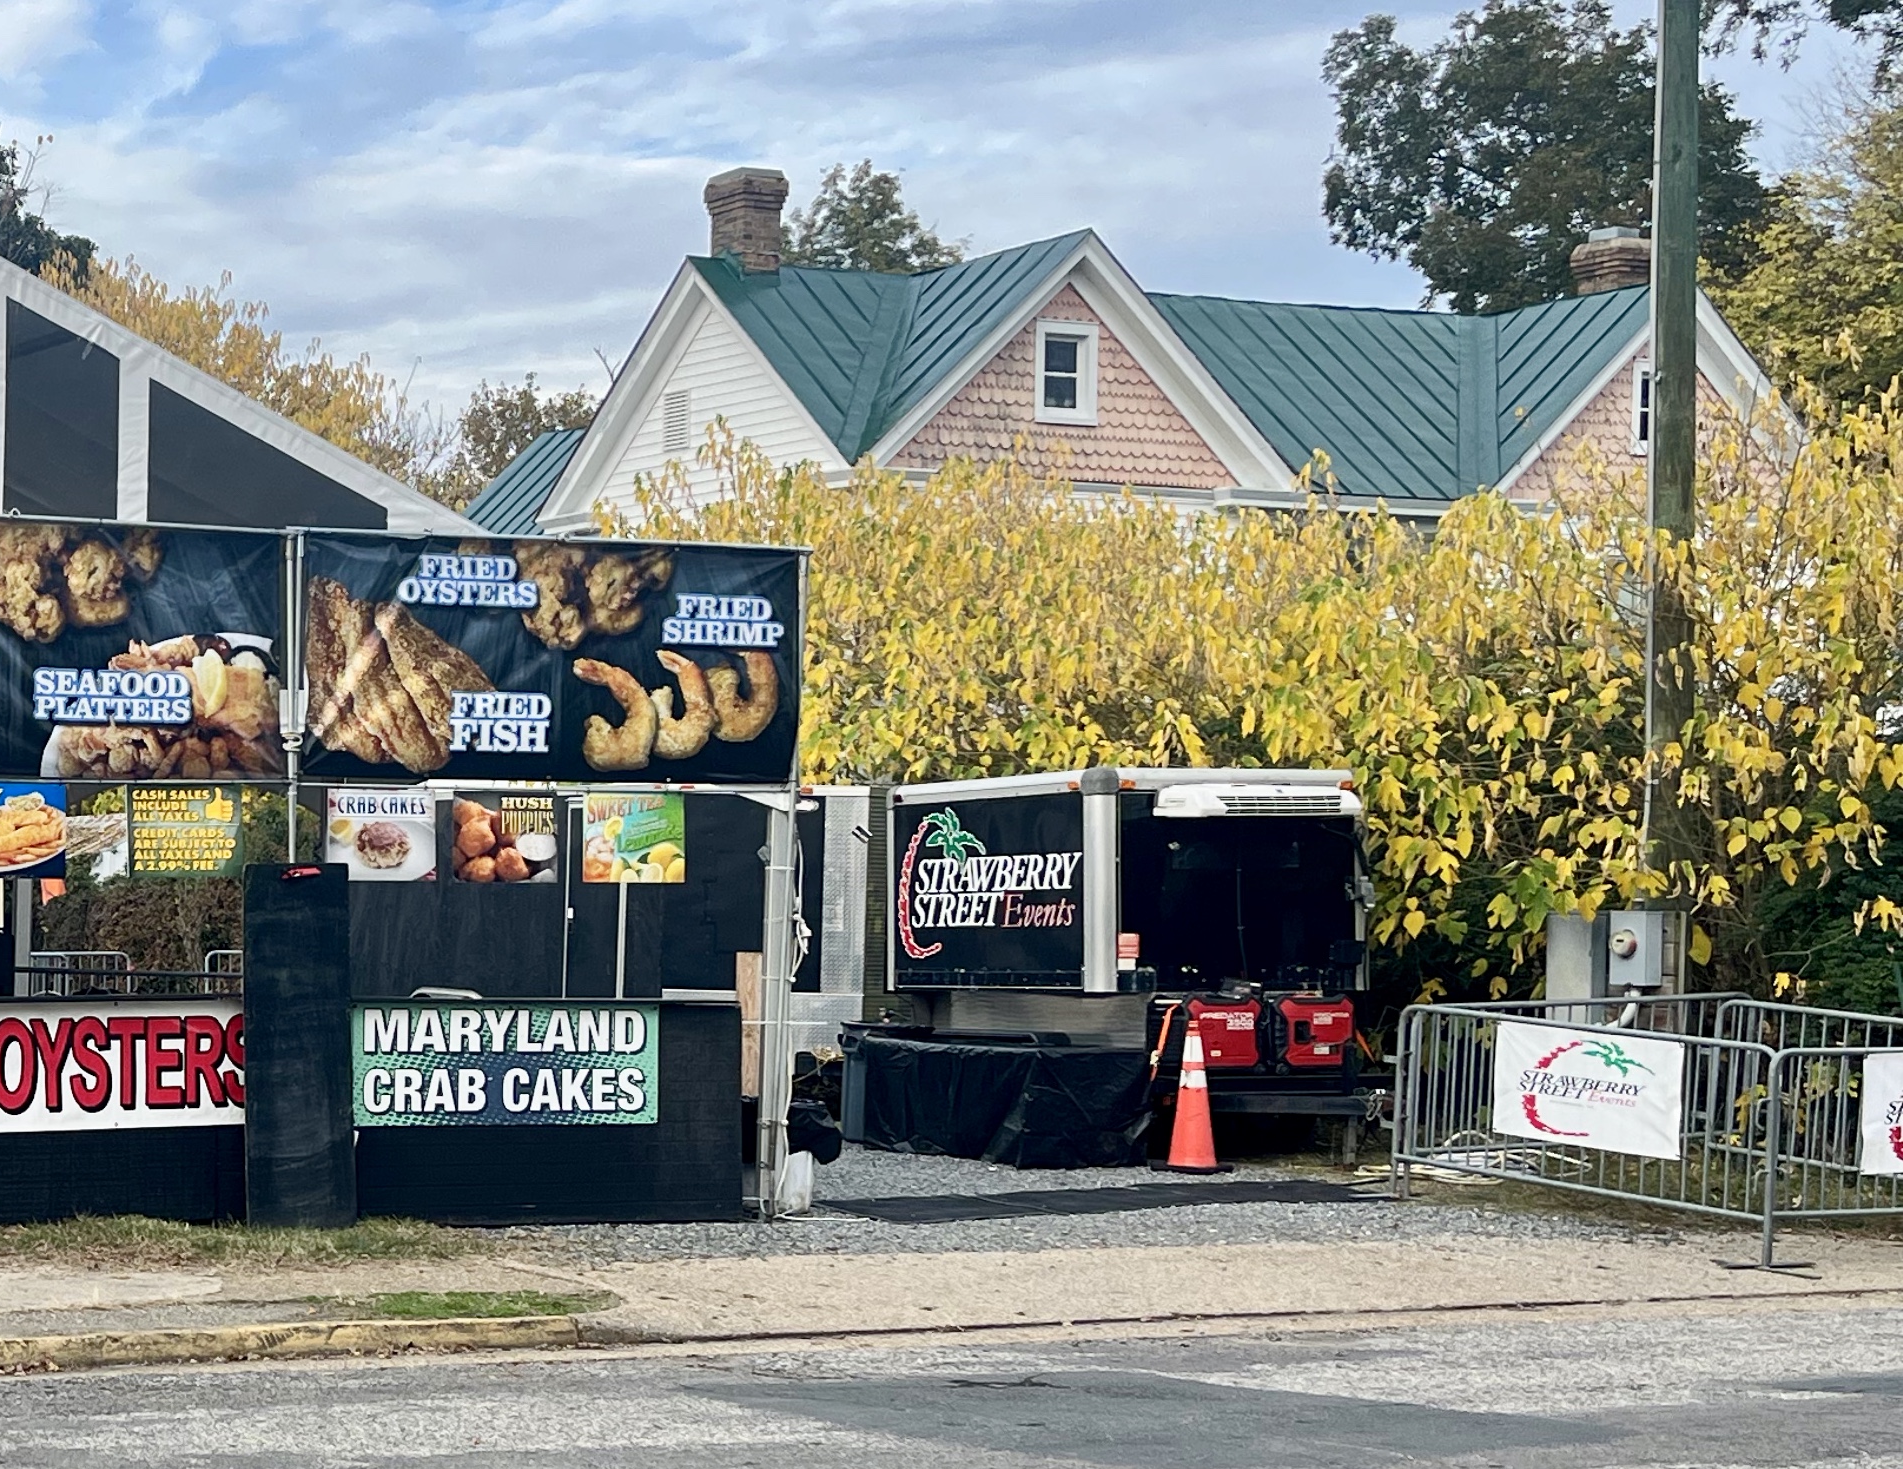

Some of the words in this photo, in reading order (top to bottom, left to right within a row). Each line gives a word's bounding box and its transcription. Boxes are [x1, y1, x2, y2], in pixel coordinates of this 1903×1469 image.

[419, 555, 517, 580] FRIED
[398, 580, 537, 607] OYSTERS
[675, 595, 773, 622] FRIED
[662, 619, 785, 647] SHRIMP
[34, 669, 191, 698] SEAFOOD
[34, 697, 191, 724] PLATTERS
[451, 692, 552, 719] FRIED
[450, 718, 550, 753] FISH
[132, 790, 167, 800] CASH
[170, 790, 210, 800] SALES
[133, 801, 187, 810] INCLUDE
[338, 796, 377, 814] CRAB
[381, 797, 425, 815] CAKES
[502, 797, 553, 809] HUSH
[133, 812, 156, 821] ALL
[502, 810, 554, 834] PUPPIES
[133, 828, 177, 838] CREDIT
[182, 828, 225, 838] CARDS
[134, 838, 159, 849] ARE
[161, 838, 215, 849] SUBJECT
[218, 838, 236, 849] TO
[134, 850, 156, 859] ALL
[159, 850, 199, 859] TAXES
[203, 850, 233, 859] AND
[134, 861, 145, 871] A
[147, 861, 191, 871] 2.99%
[193, 861, 219, 871] FEE.
[915, 852, 1082, 893] STRAWBERRY
[912, 892, 1003, 928] STREET
[1002, 894, 1075, 928] Events
[363, 1008, 648, 1055] MARYLAND
[363, 1068, 487, 1114] CRAB
[502, 1068, 647, 1113] CAKES
[1517, 1080, 1588, 1100] STREET
[1589, 1090, 1637, 1107] Events
[1520, 1069, 1647, 1097] STRAWBERRY
